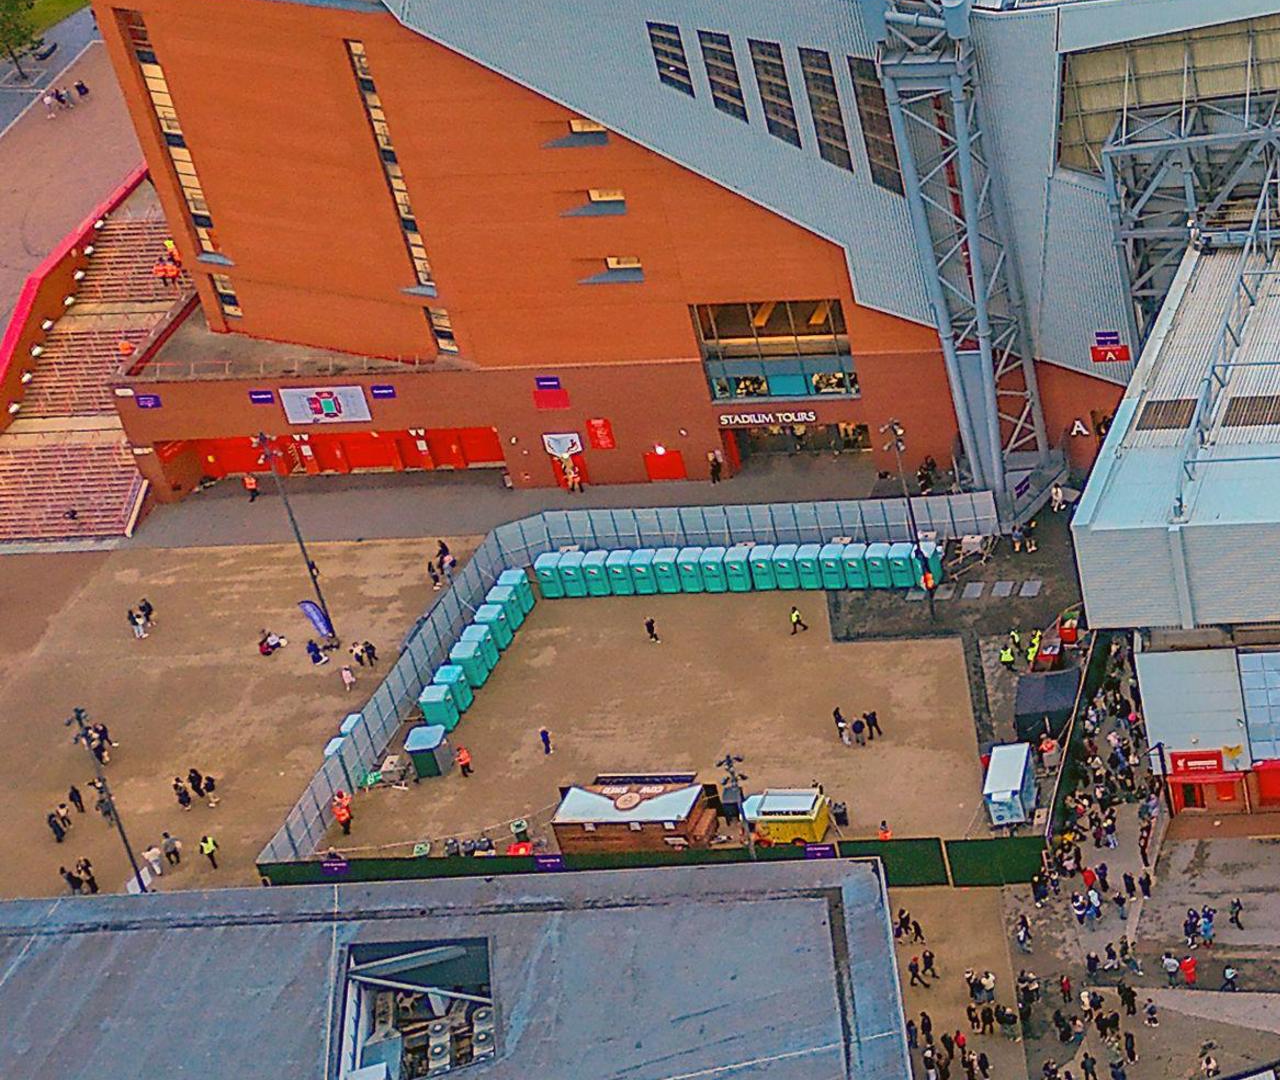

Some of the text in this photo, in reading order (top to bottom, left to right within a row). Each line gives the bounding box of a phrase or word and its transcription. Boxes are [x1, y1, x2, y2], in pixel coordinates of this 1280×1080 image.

[720, 411, 816, 425] STADIUM TOURS
[639, 786, 664, 794] COW
